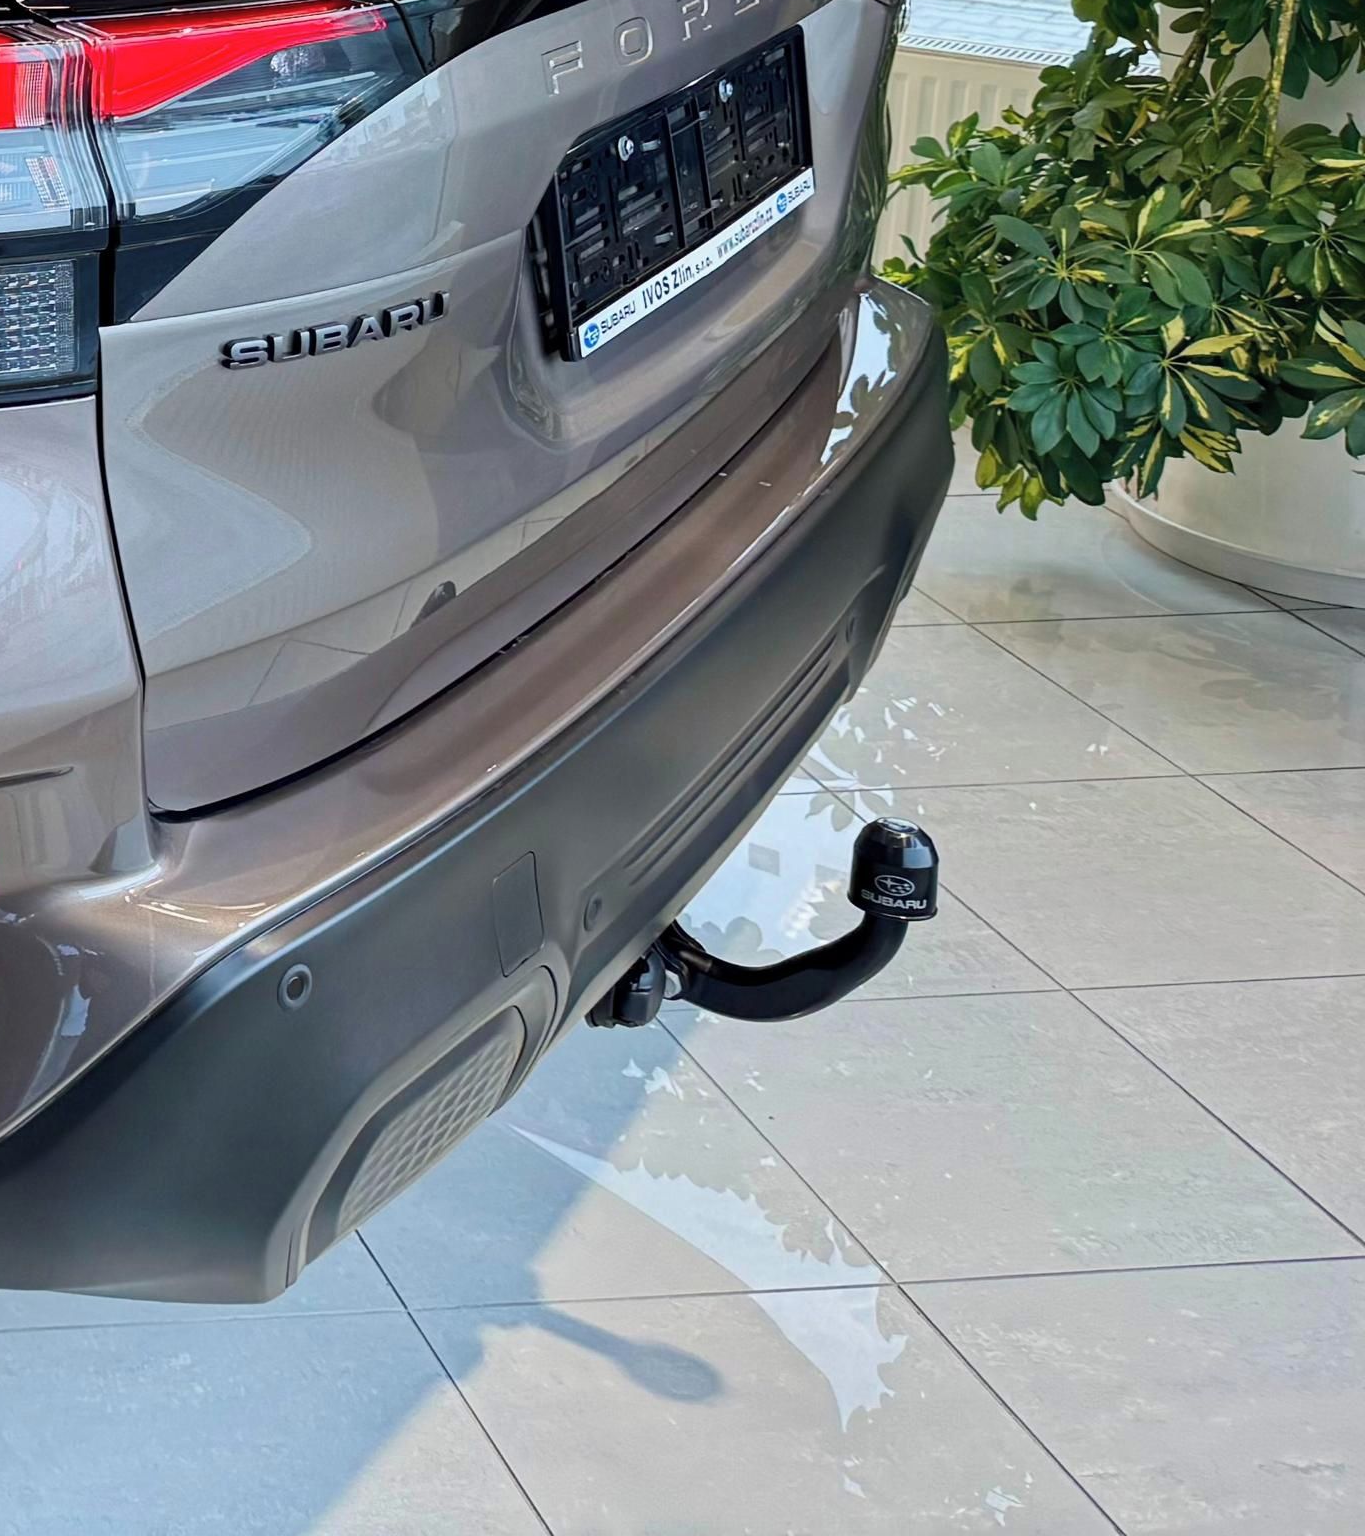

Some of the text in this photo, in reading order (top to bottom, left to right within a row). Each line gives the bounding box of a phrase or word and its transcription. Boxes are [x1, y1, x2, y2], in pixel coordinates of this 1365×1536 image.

[218, 289, 451, 370] SUBARU
[600, 300, 637, 336] SUBARU
[641, 275, 671, 309] IVOS
[860, 888, 928, 910] SUBARU
